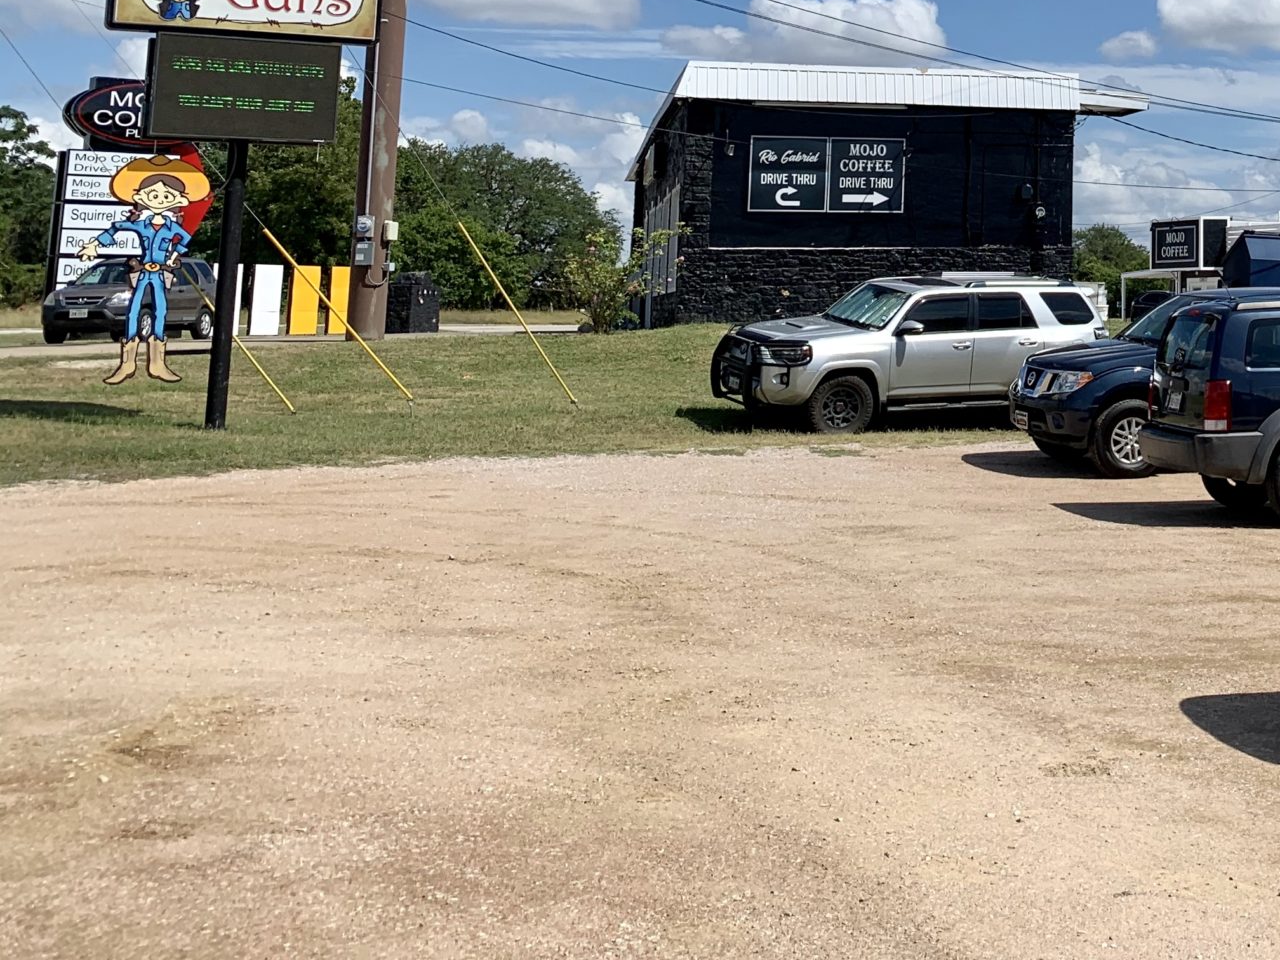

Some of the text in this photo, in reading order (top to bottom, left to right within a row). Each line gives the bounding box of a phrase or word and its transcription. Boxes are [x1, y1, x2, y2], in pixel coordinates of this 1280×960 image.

[849, 143, 887, 157] MOJO
[75, 153, 107, 163] Mojo
[759, 149, 821, 164] Rio Gabriel
[839, 159, 894, 172] COFFEE
[72, 179, 101, 189] Mojo
[760, 173, 817, 185] DRIVE THRU
[839, 177, 894, 189] DRIVE THRU
[71, 189, 112, 199] Espres
[71, 208, 116, 223] Squirrel
[66, 236, 84, 248] Rio
[1165, 232, 1185, 243] MOJO
[1161, 245, 1189, 257] COFFEE
